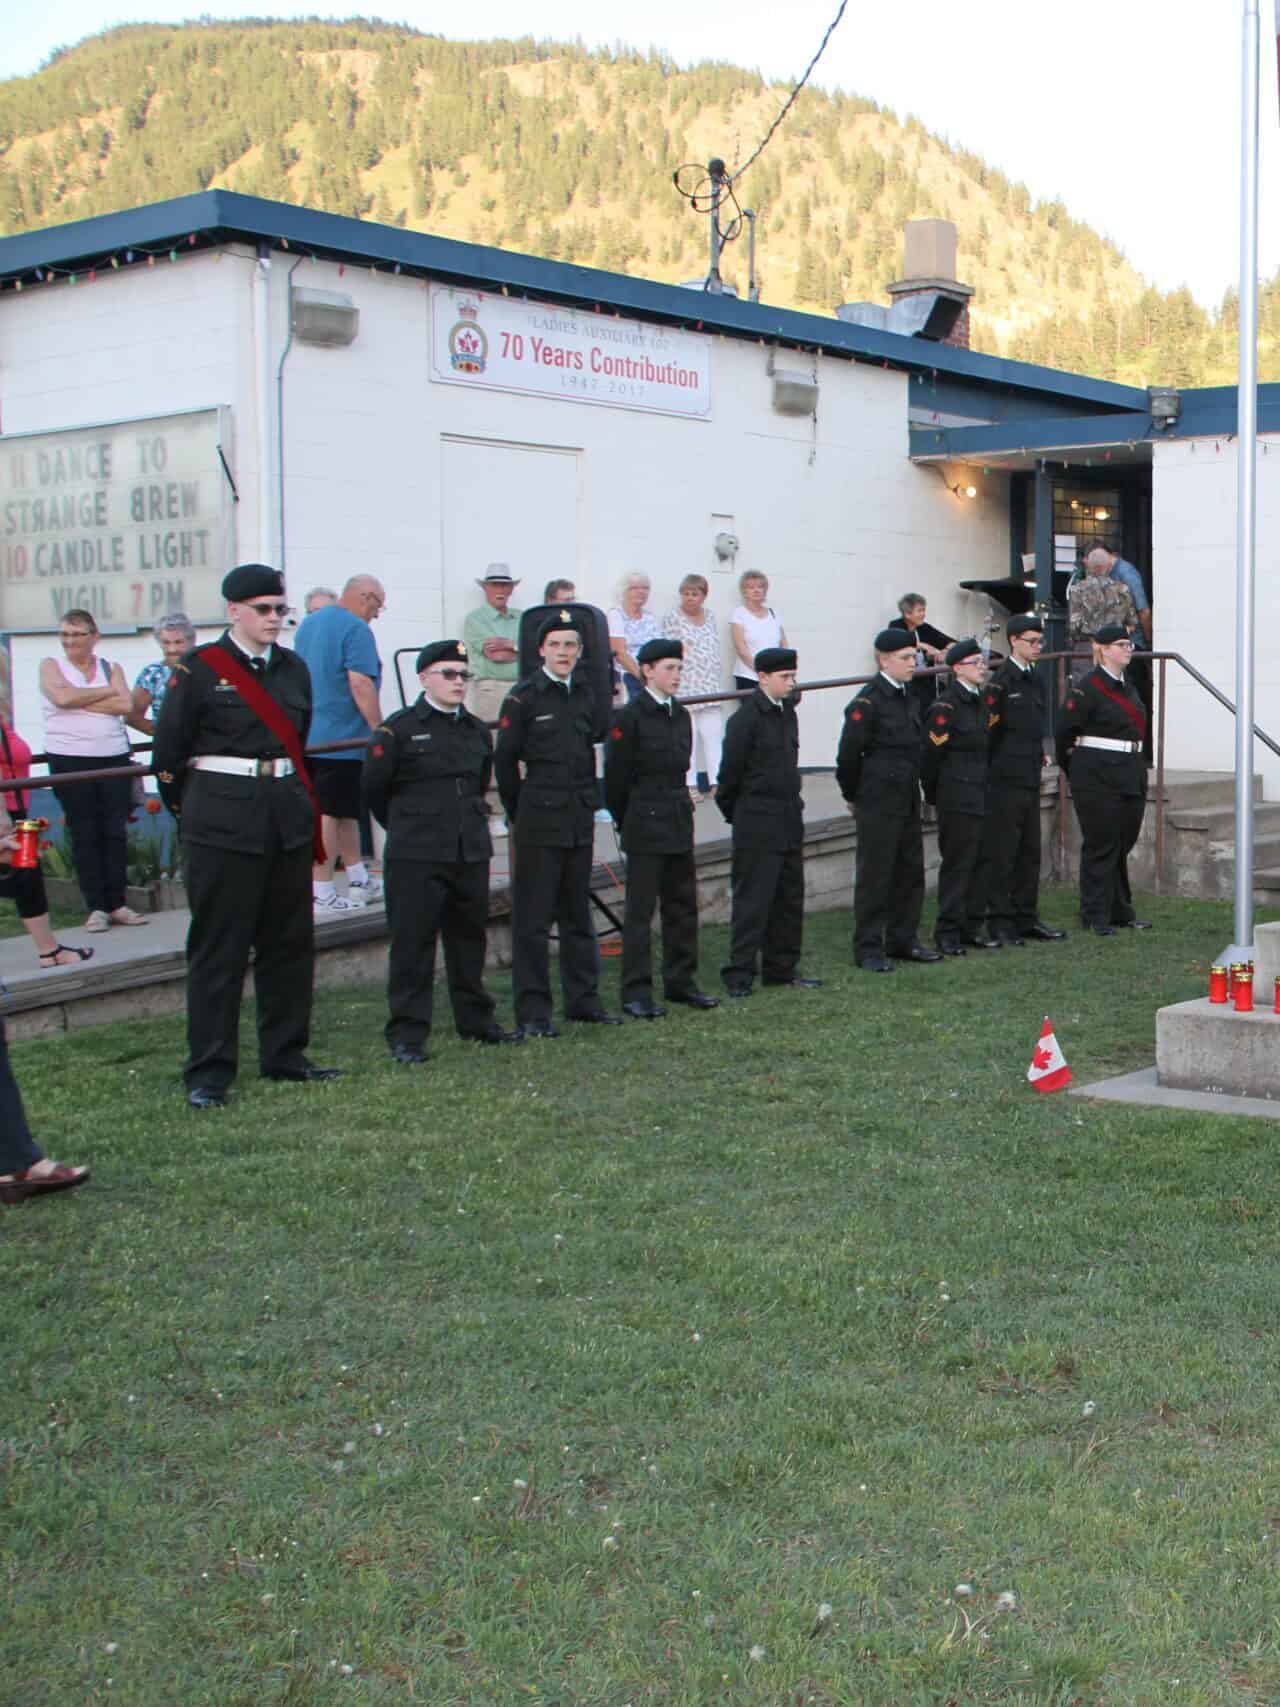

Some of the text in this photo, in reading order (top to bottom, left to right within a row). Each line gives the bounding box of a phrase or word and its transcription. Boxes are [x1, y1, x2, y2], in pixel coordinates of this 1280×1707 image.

[499, 332, 699, 389] 70 Years Contribution
[37, 443, 112, 485] DANCE
[136, 436, 168, 473] TO
[4, 480, 199, 536] STRANGE BREW
[34, 536, 125, 577] CANDLE
[139, 529, 210, 570] LIGHT
[52, 585, 113, 620] VIGIL
